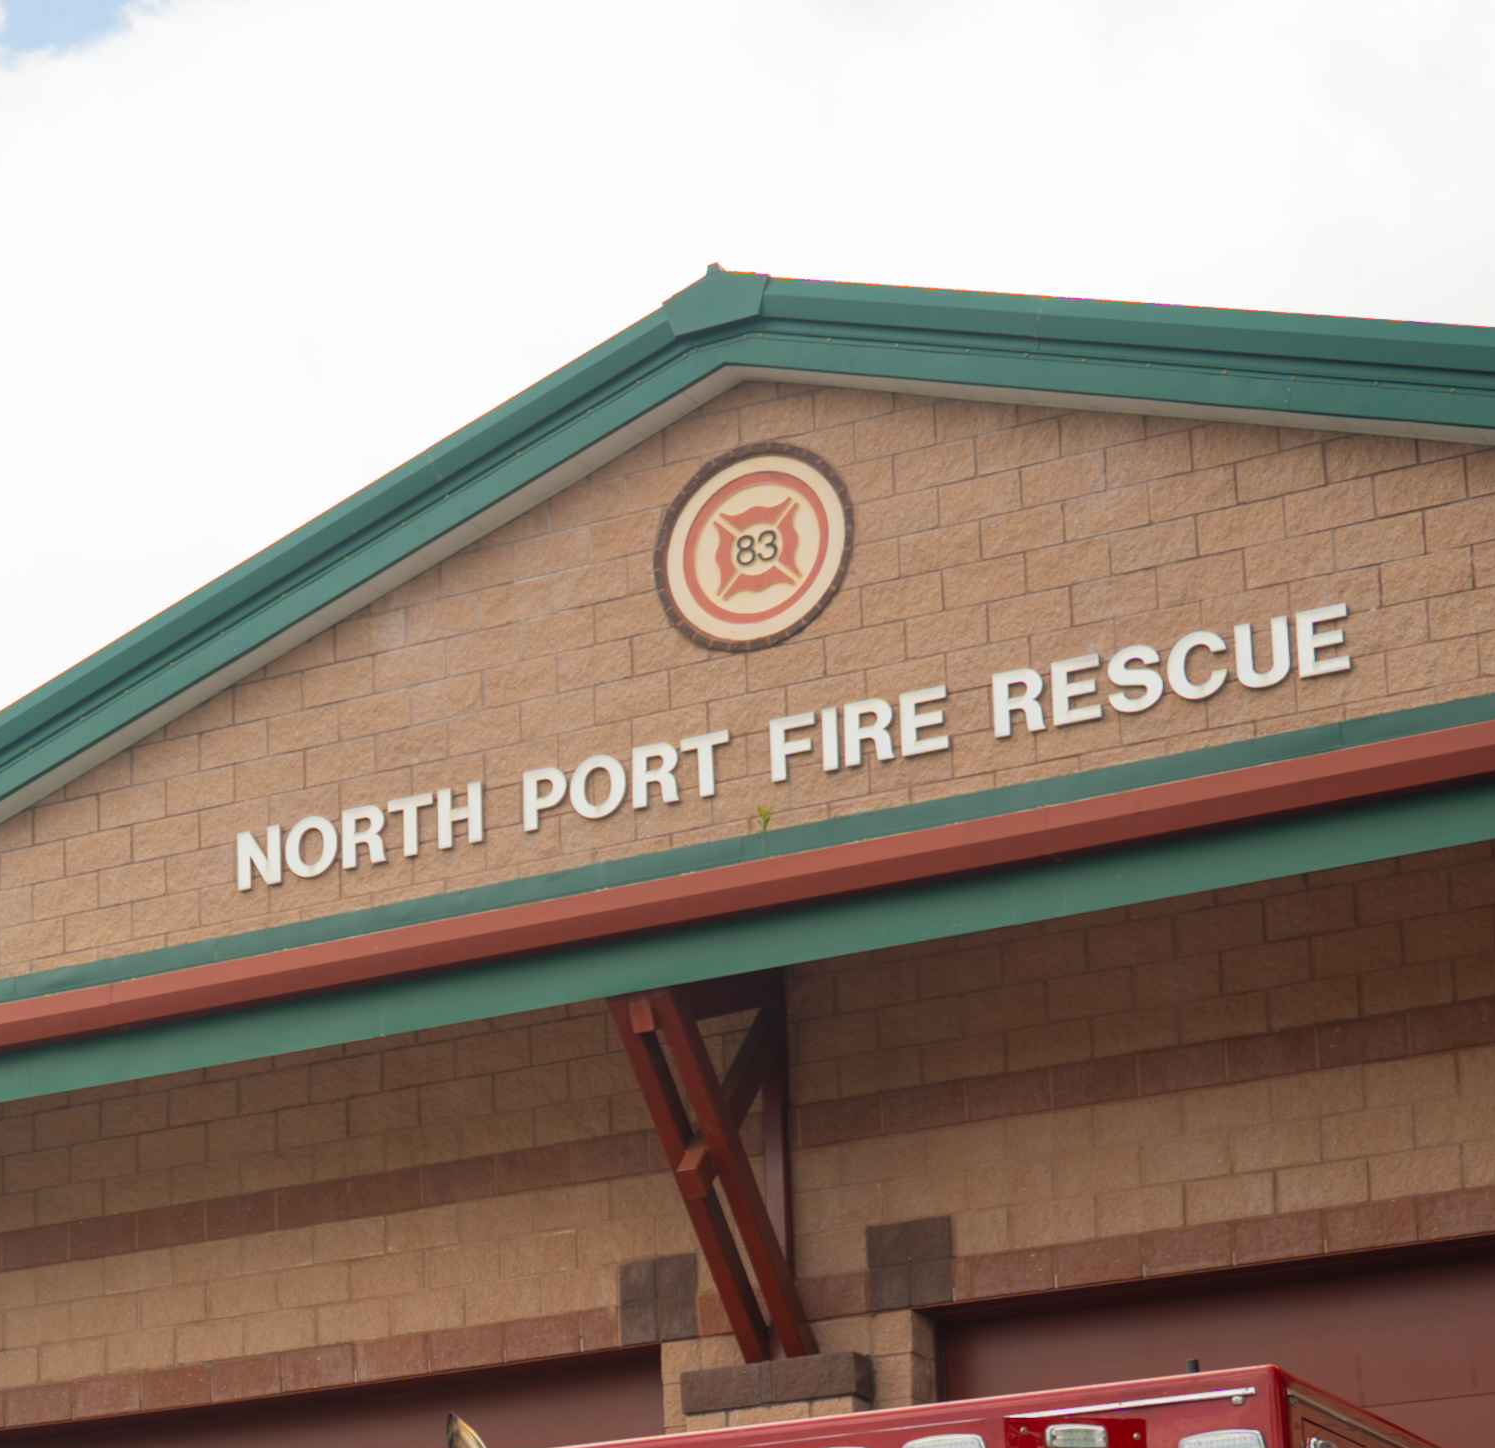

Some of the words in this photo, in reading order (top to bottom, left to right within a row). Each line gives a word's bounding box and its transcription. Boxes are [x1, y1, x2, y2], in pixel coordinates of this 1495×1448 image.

[736, 530, 778, 567] 83
[236, 781, 484, 892] NORTH
[522, 729, 730, 833] PORT
[769, 685, 950, 783] FIRE
[991, 602, 1352, 739] RESCUE
